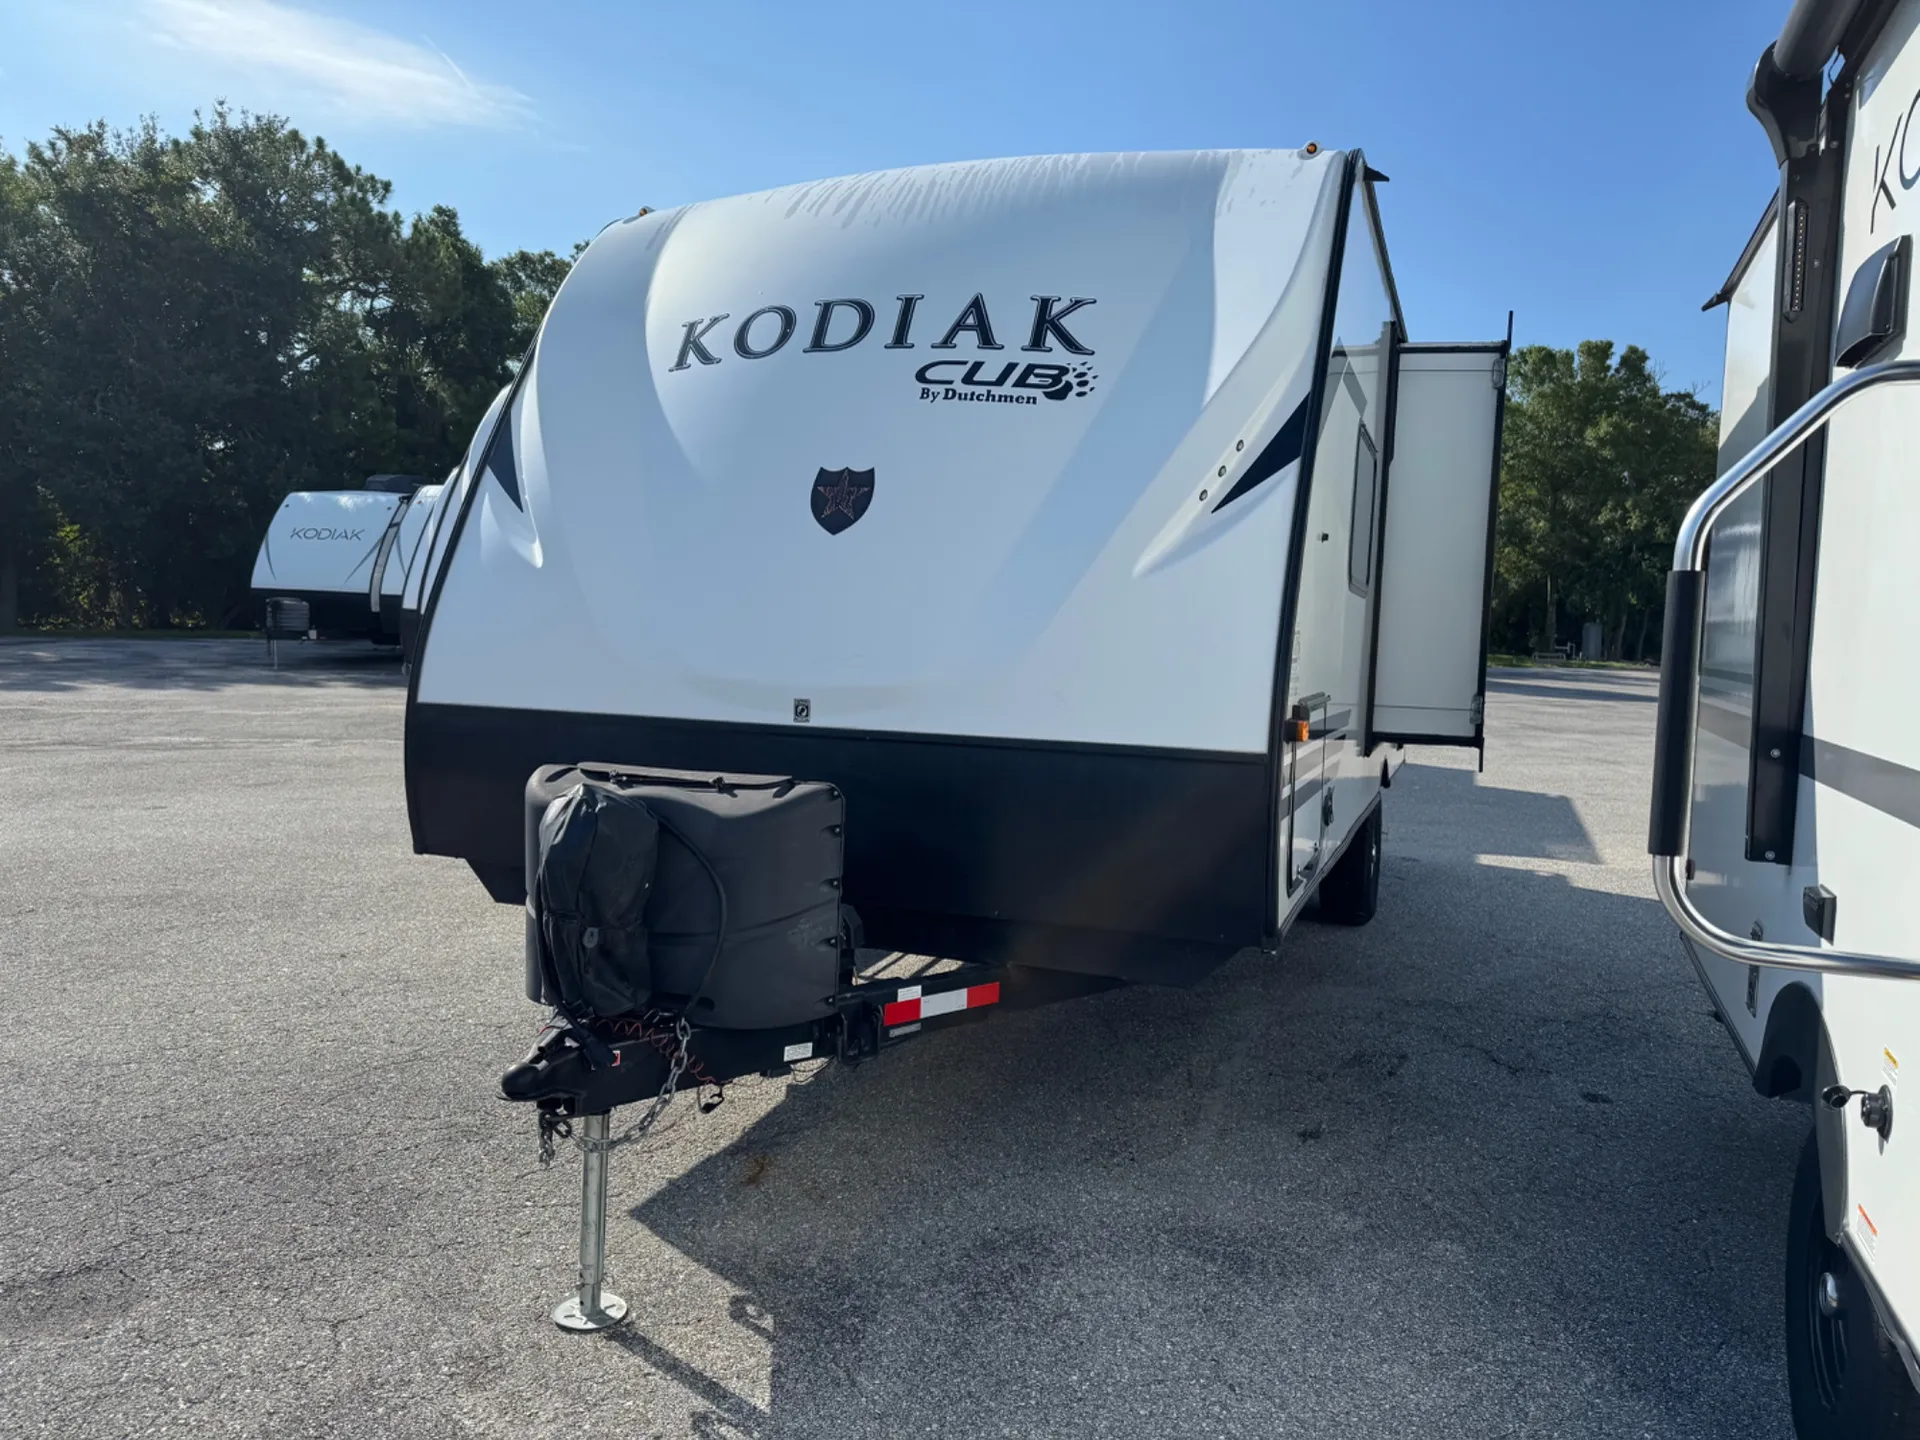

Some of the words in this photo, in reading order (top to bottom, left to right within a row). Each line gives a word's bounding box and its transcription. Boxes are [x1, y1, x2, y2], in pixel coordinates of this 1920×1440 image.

[668, 292, 1097, 372] KODIAK
[915, 360, 1070, 389] CUB
[919, 387, 940, 403] By
[943, 388, 1037, 405] Dutchmen
[290, 527, 365, 541] KODIAK
